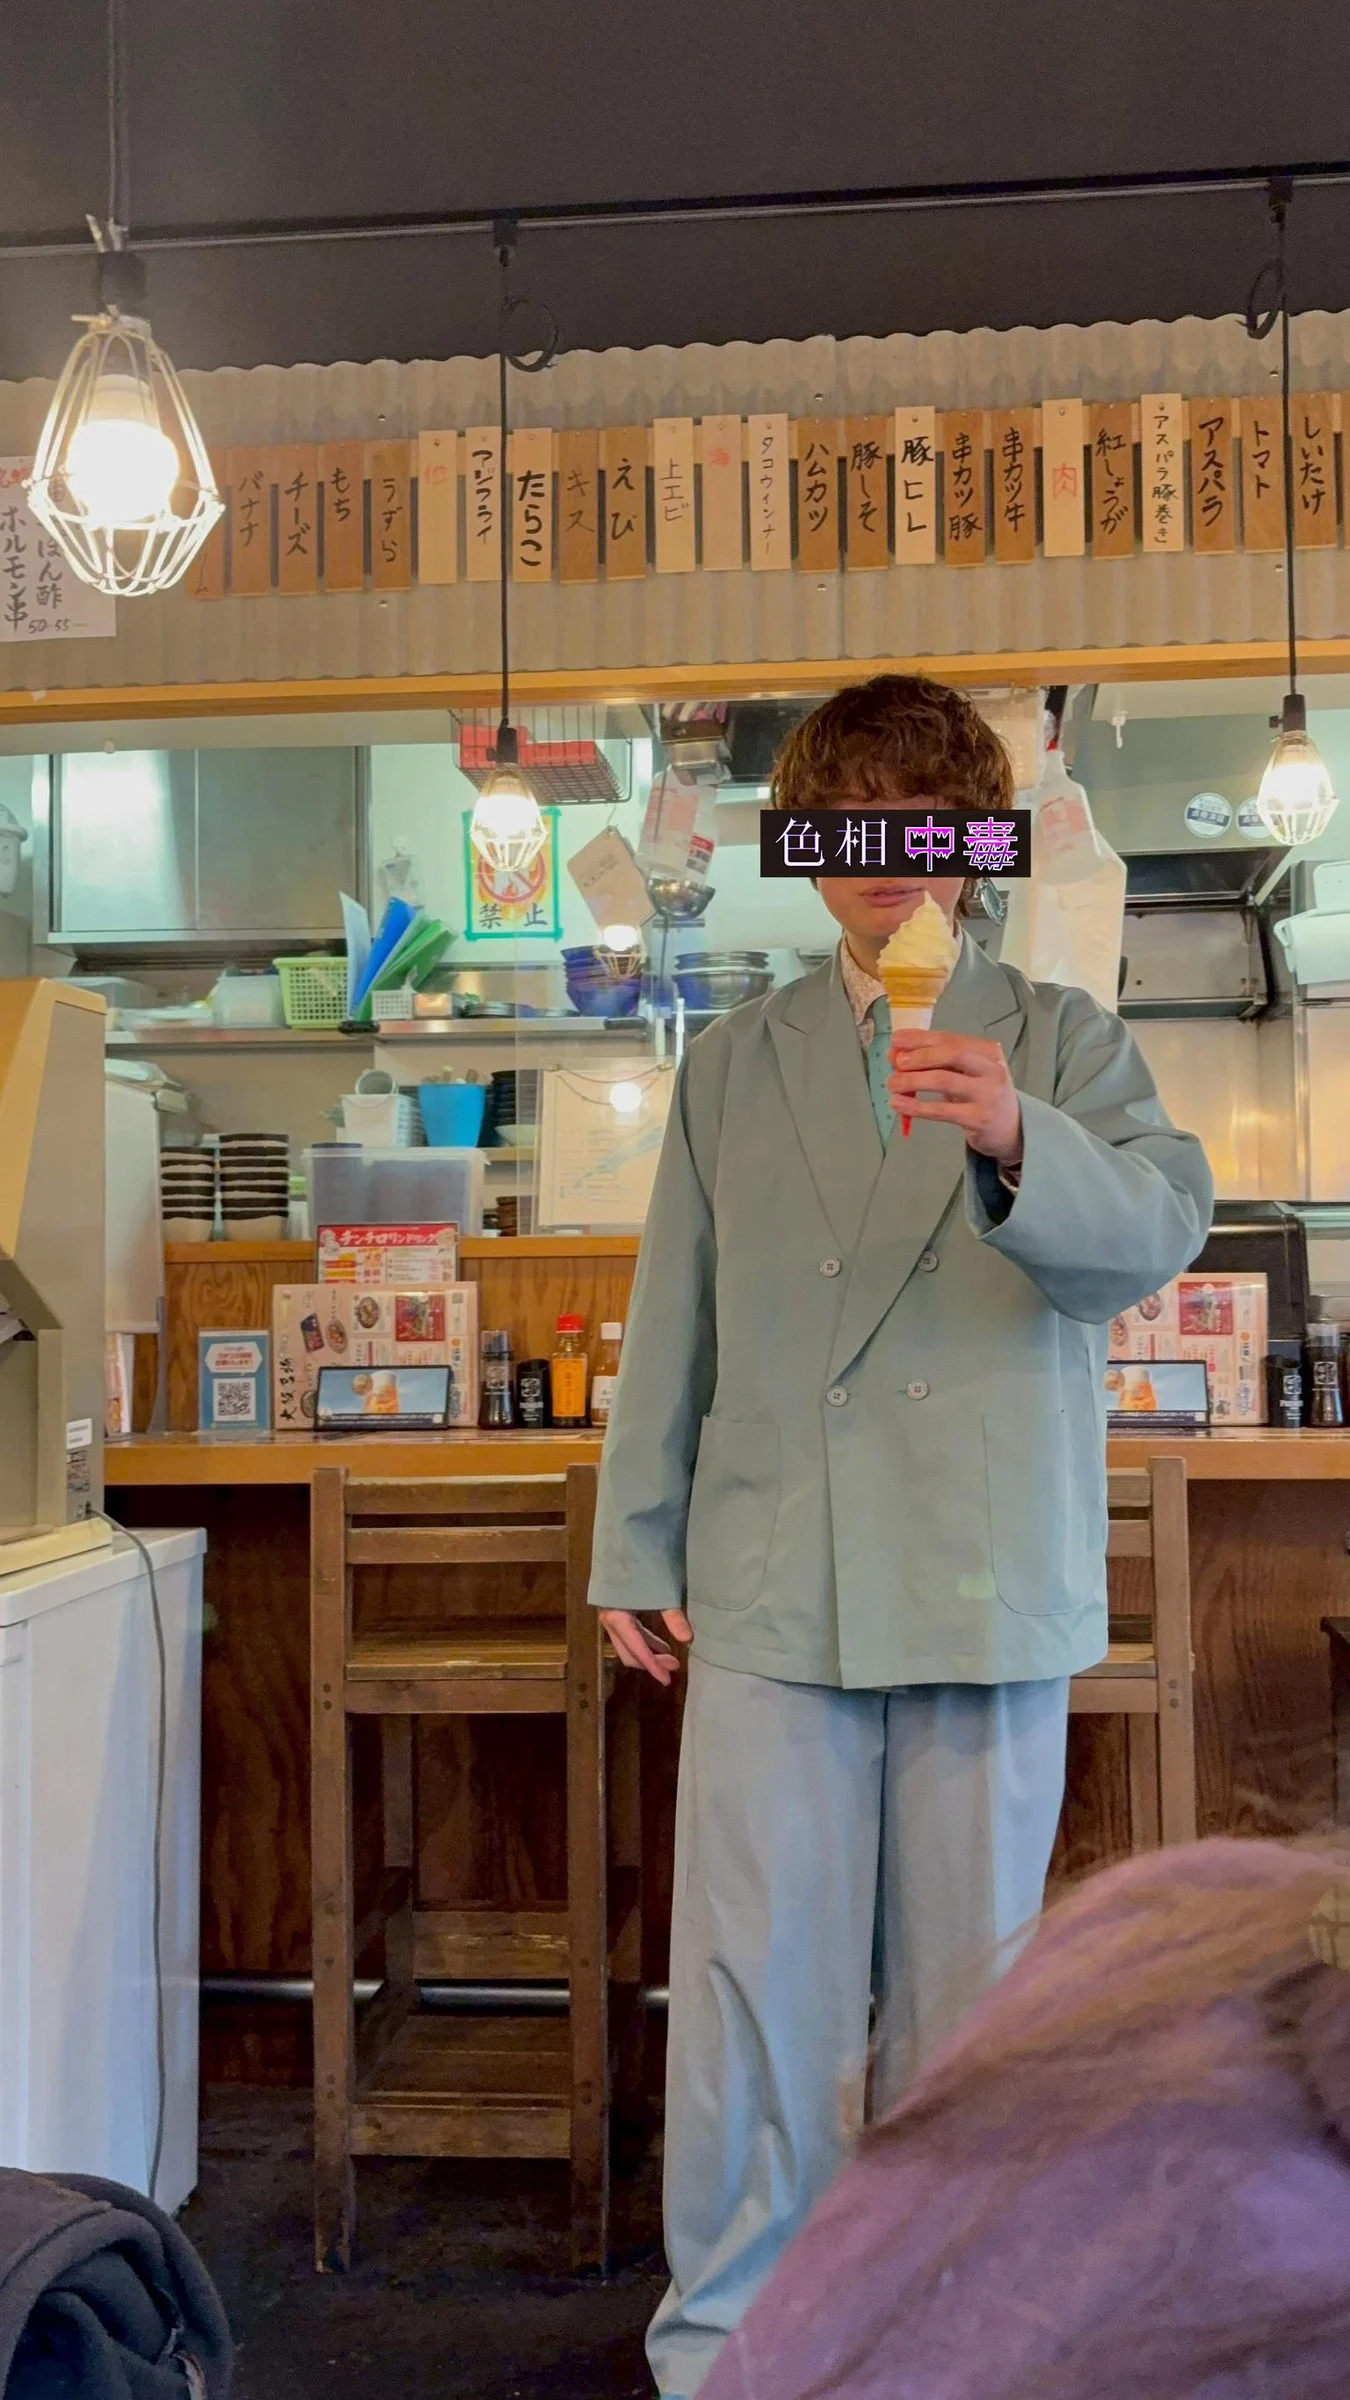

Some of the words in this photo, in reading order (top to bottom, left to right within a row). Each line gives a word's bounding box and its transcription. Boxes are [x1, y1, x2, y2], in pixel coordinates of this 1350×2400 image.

[331, 467, 351, 522] もち
[564, 469, 594, 533] キス
[610, 458, 637, 540] えび
[804, 443, 830, 533] ハムカツ
[850, 441, 883, 533] 豚しそ
[901, 436, 934, 533] 豚ヒレ
[949, 432, 983, 541] 串カツ豚
[1002, 427, 1025, 532] 串カツ牛
[1053, 463, 1077, 499] 肉
[1096, 428, 1128, 535] 紅しょうが
[1152, 414, 1178, 544] アスパラ豚巻き
[1198, 416, 1225, 527] アスパラ
[1253, 420, 1271, 499] トマト
[1299, 416, 1325, 516] しいたけ
[238, 470, 263, 546] バナナ
[284, 472, 310, 556] チーズ
[382, 478, 402, 562] うずら
[517, 469, 546, 567] たらこ
[479, 902, 549, 929] 禁止
